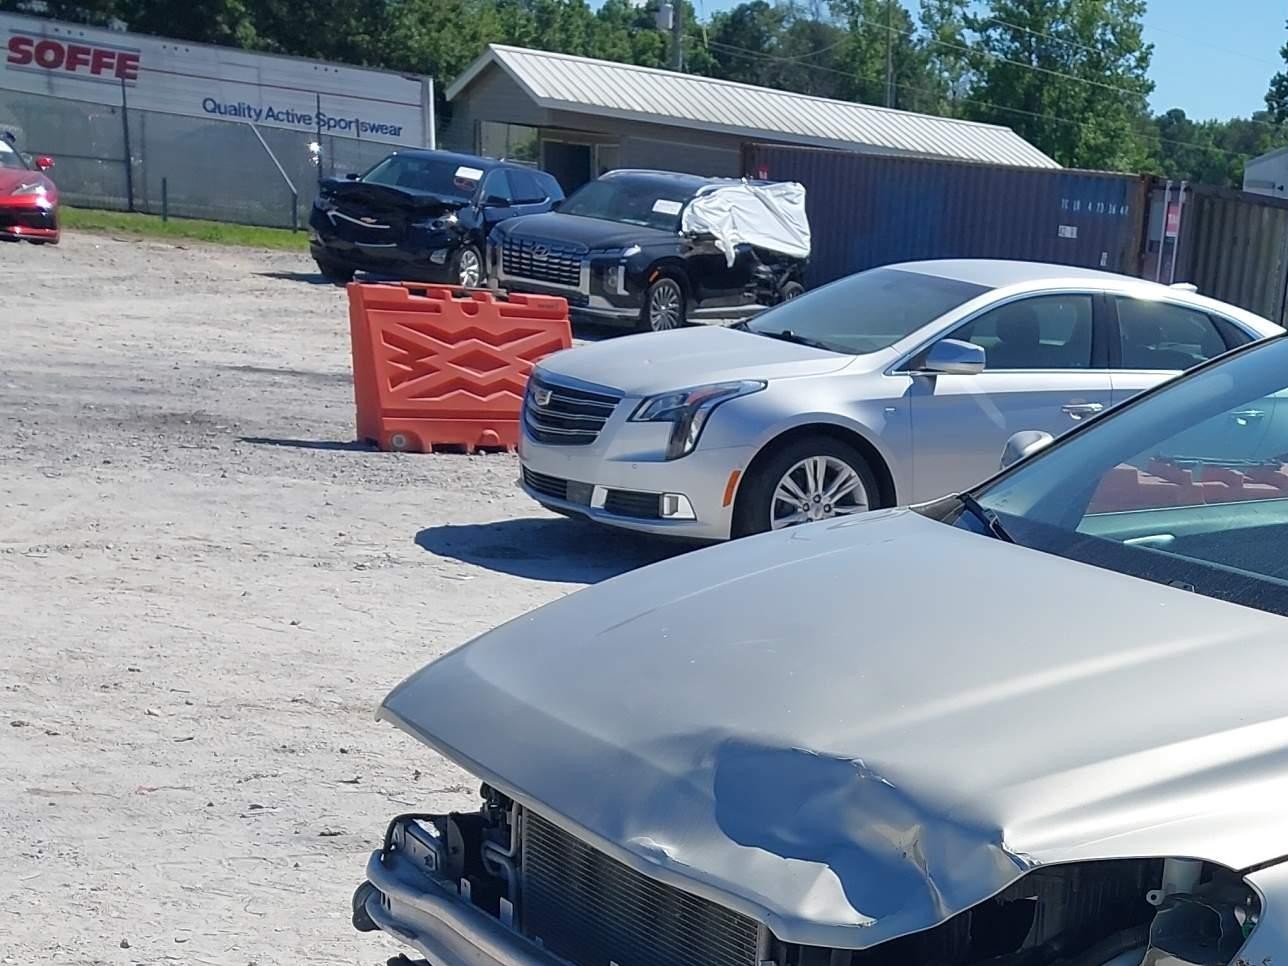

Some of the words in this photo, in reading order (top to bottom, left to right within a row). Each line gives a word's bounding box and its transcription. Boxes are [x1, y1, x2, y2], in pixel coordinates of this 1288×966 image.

[7, 36, 140, 80] SOFFE
[202, 97, 262, 122] Quality
[265, 105, 312, 126] Active
[315, 112, 403, 138] Sportswear
